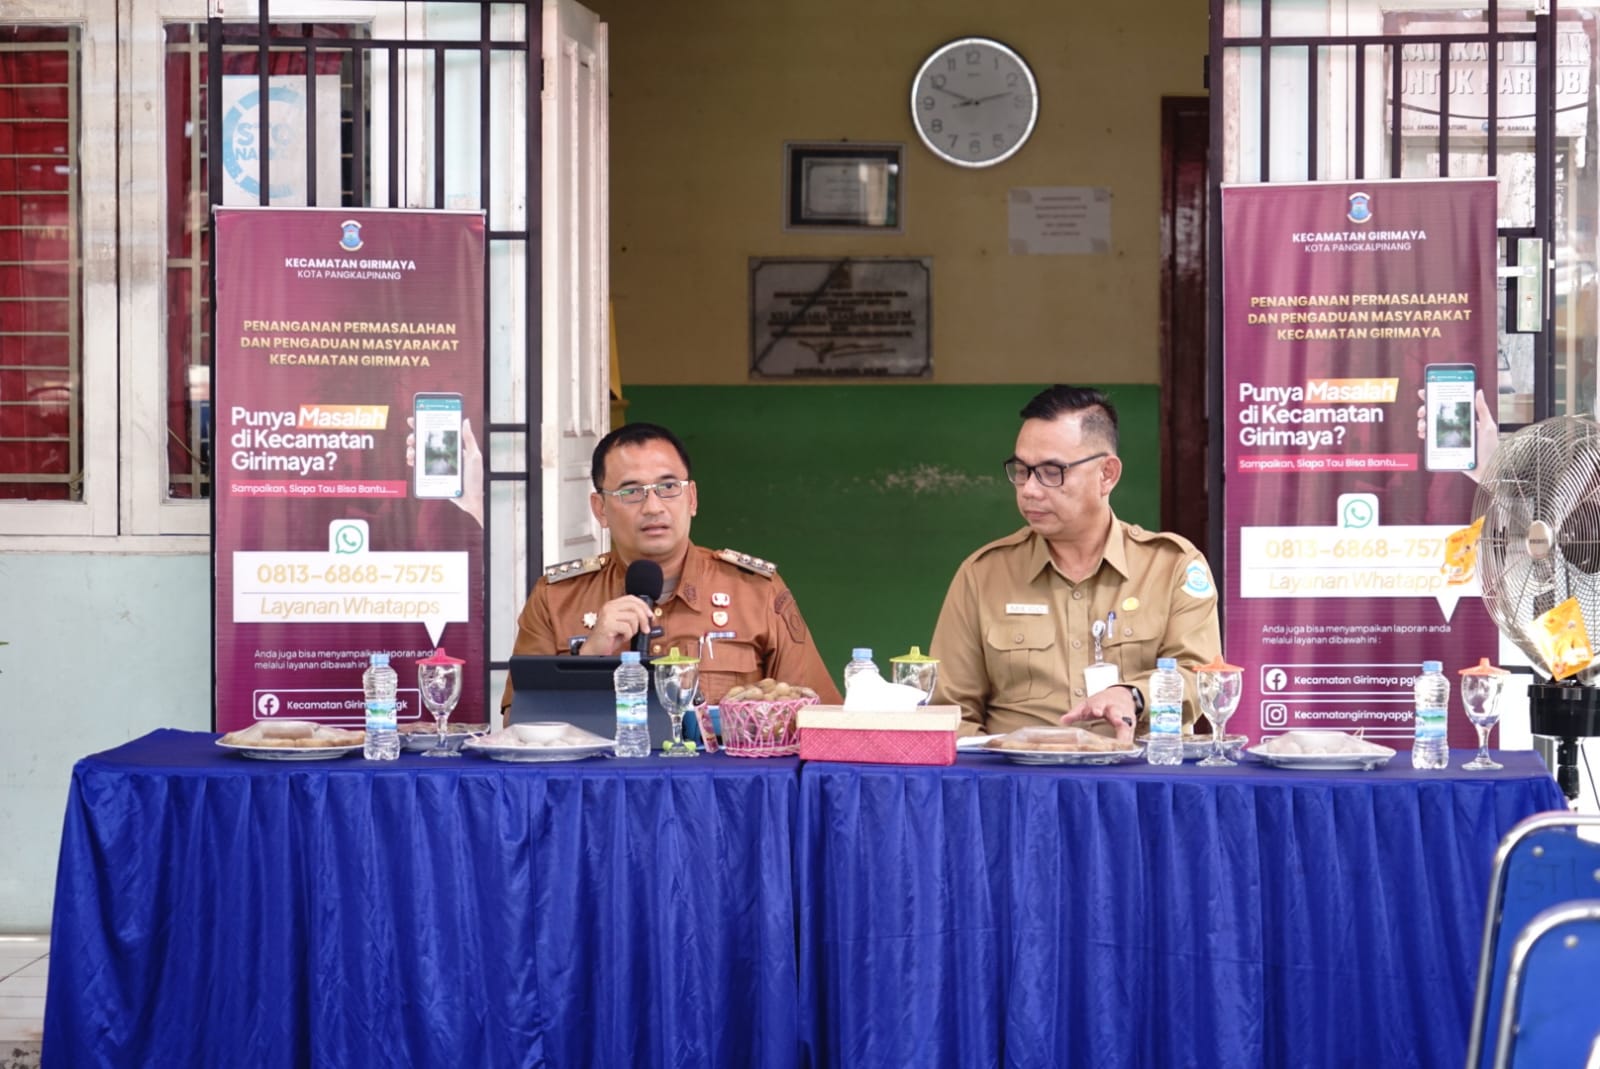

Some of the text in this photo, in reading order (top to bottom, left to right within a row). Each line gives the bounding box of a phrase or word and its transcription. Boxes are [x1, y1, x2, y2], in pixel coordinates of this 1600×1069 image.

[1292, 230, 1426, 242] KECAMATAN GIRIMAYA
[1304, 242, 1412, 252] KOTA PANGKALPINANG
[285, 258, 416, 270] KECAMATAN GIRIMAYA
[298, 270, 402, 280] KOTA PANGKALPINANG
[1251, 293, 1468, 308] PENANGANAN PERMASALAHAN
[1248, 310, 1472, 324] DAN PENGADUAN MASYARAKAT
[244, 320, 456, 334] PENANGANAN PERMASALAHAN
[1277, 327, 1442, 340] KECAMATAN GIRIMAYA
[240, 337, 460, 351] DAN PENGADUAN MASYARAKAT
[270, 354, 430, 368] KECAMATAN GIRIMAYA
[1239, 380, 1396, 407] Punya Masalah
[231, 406, 386, 430] Punya Masalah
[1239, 404, 1384, 424] di Kecamatan
[231, 429, 374, 450] di Kecamatan
[1239, 426, 1346, 450] Girimaya?
[231, 451, 337, 476] Girimaya?
[1239, 459, 1295, 470] Sampaikan,
[1297, 459, 1325, 470] Siapa
[1326, 459, 1344, 467] Tau
[1346, 458, 1366, 467] Bisa
[232, 484, 287, 494] Sampaikan,
[289, 484, 316, 495] Siapa
[318, 484, 335, 493] Tau
[337, 484, 356, 493] Bisa
[1265, 538, 1443, 558] 0813-6868-757
[256, 564, 444, 584] 0813-6868-7575
[1352, 571, 1444, 592] Whatapp
[260, 596, 440, 619] Layanan Whatapps
[1262, 624, 1451, 635] Anda juga bisa menyampaikan laporan anda
[1262, 636, 1292, 644] melalui
[1294, 636, 1328, 646] layanan
[1328, 635, 1366, 644] dibawah
[1367, 635, 1377, 644] ini
[254, 650, 277, 658] Anda
[278, 650, 297, 660] juga
[298, 650, 316, 658] bisa
[254, 661, 368, 671] melalui layanan dibawah ini
[1294, 676, 1351, 685] Kecamatan
[1353, 676, 1398, 686] Girimaya
[287, 700, 342, 710] Kecamatan
[344, 700, 366, 710] Girim
[1294, 710, 1413, 722] Kecamatangirimayapgk
